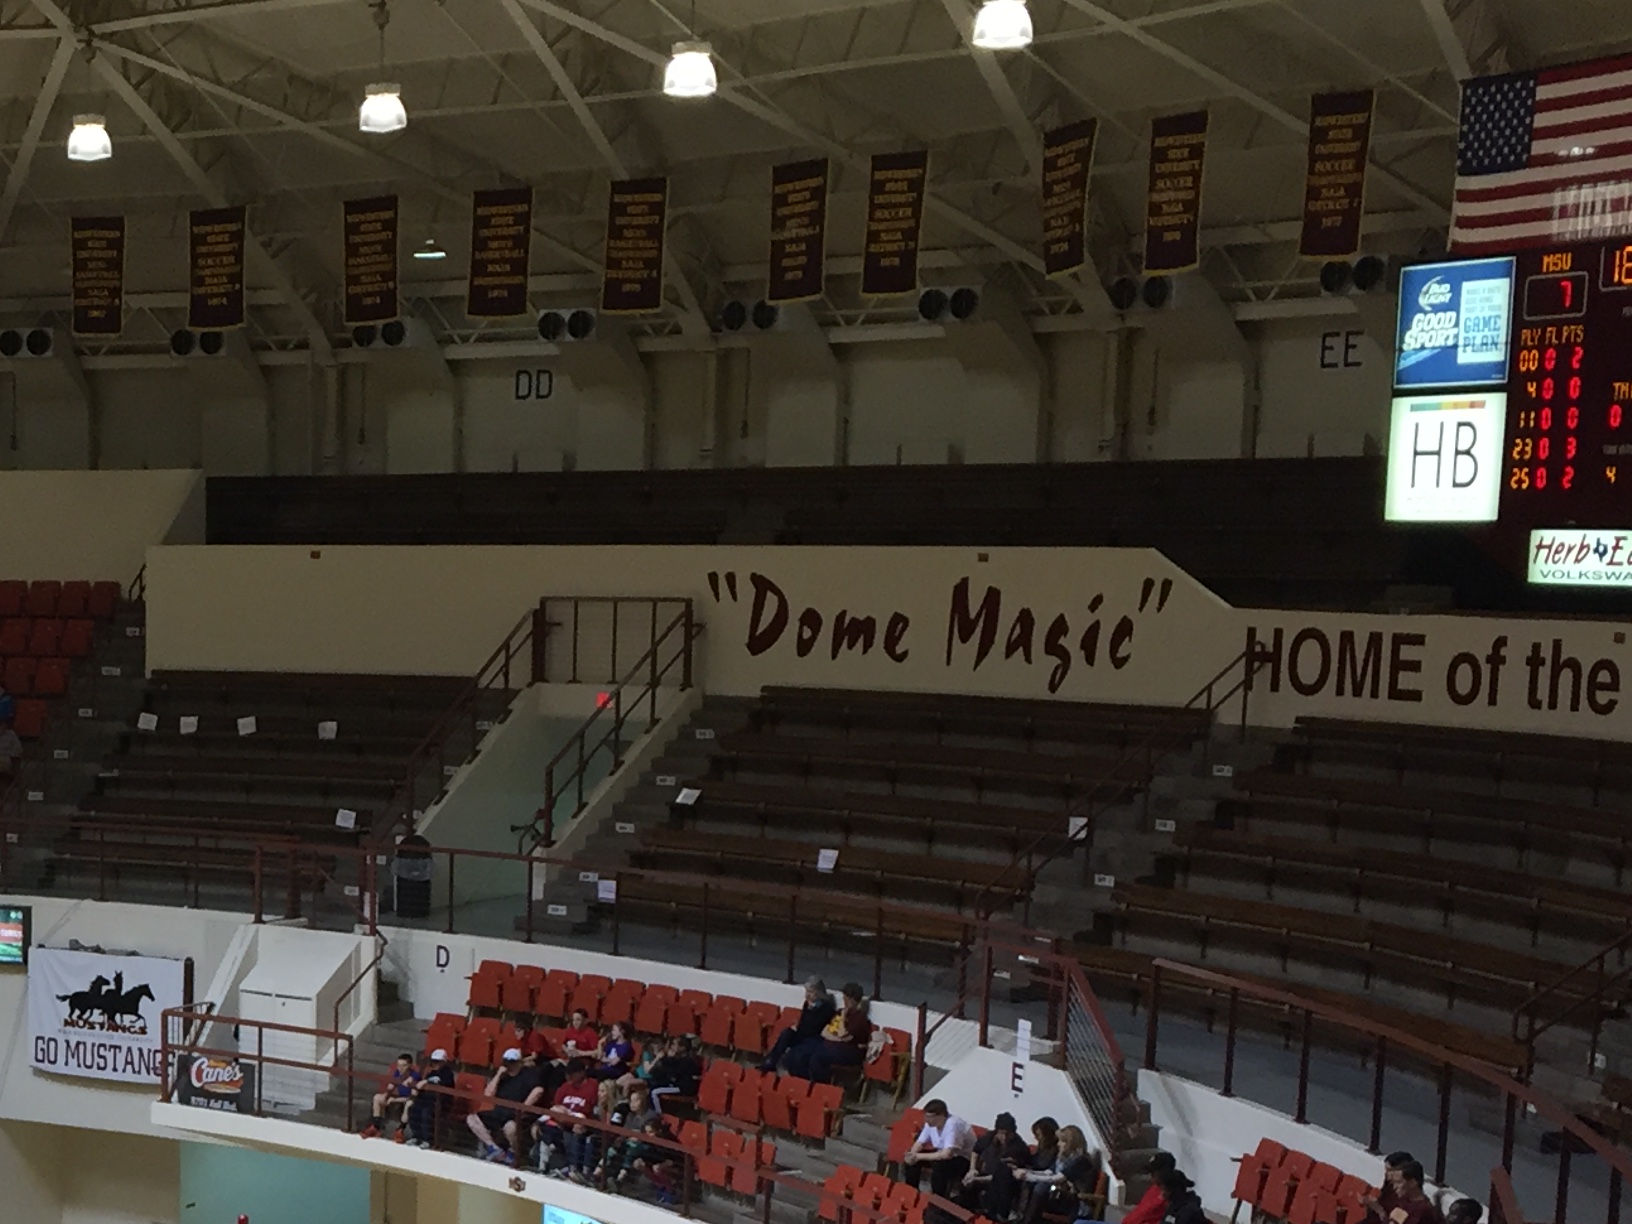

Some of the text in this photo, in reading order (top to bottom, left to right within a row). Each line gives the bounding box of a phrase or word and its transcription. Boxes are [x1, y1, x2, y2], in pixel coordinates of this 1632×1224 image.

[1542, 252, 1572, 273] MSU
[1561, 280, 1572, 308] 7
[1412, 311, 1457, 333] GOOD
[1463, 314, 1502, 334] GAME
[1402, 328, 1459, 352] SPORT
[1521, 324, 1585, 346] PLY FL PTS
[1319, 330, 1365, 368] EE
[1519, 349, 1540, 371] 00
[1572, 346, 1584, 370] 2
[515, 369, 554, 400] DD
[1527, 381, 1537, 398] 4
[1410, 420, 1479, 489] HB
[1513, 437, 1533, 460] 23
[1567, 436, 1577, 460] 3
[1510, 466, 1530, 490] 25
[1562, 466, 1575, 490] 2
[1606, 465, 1617, 484] 4
[1532, 532, 1591, 566] Herb
[1244, 624, 1622, 715] HOME of the
[436, 944, 451, 969] D
[63, 1018, 148, 1036] MUSTANGS
[34, 1035, 59, 1064] GO
[191, 1055, 245, 1089] Cane's
[1011, 1060, 1025, 1094] E
